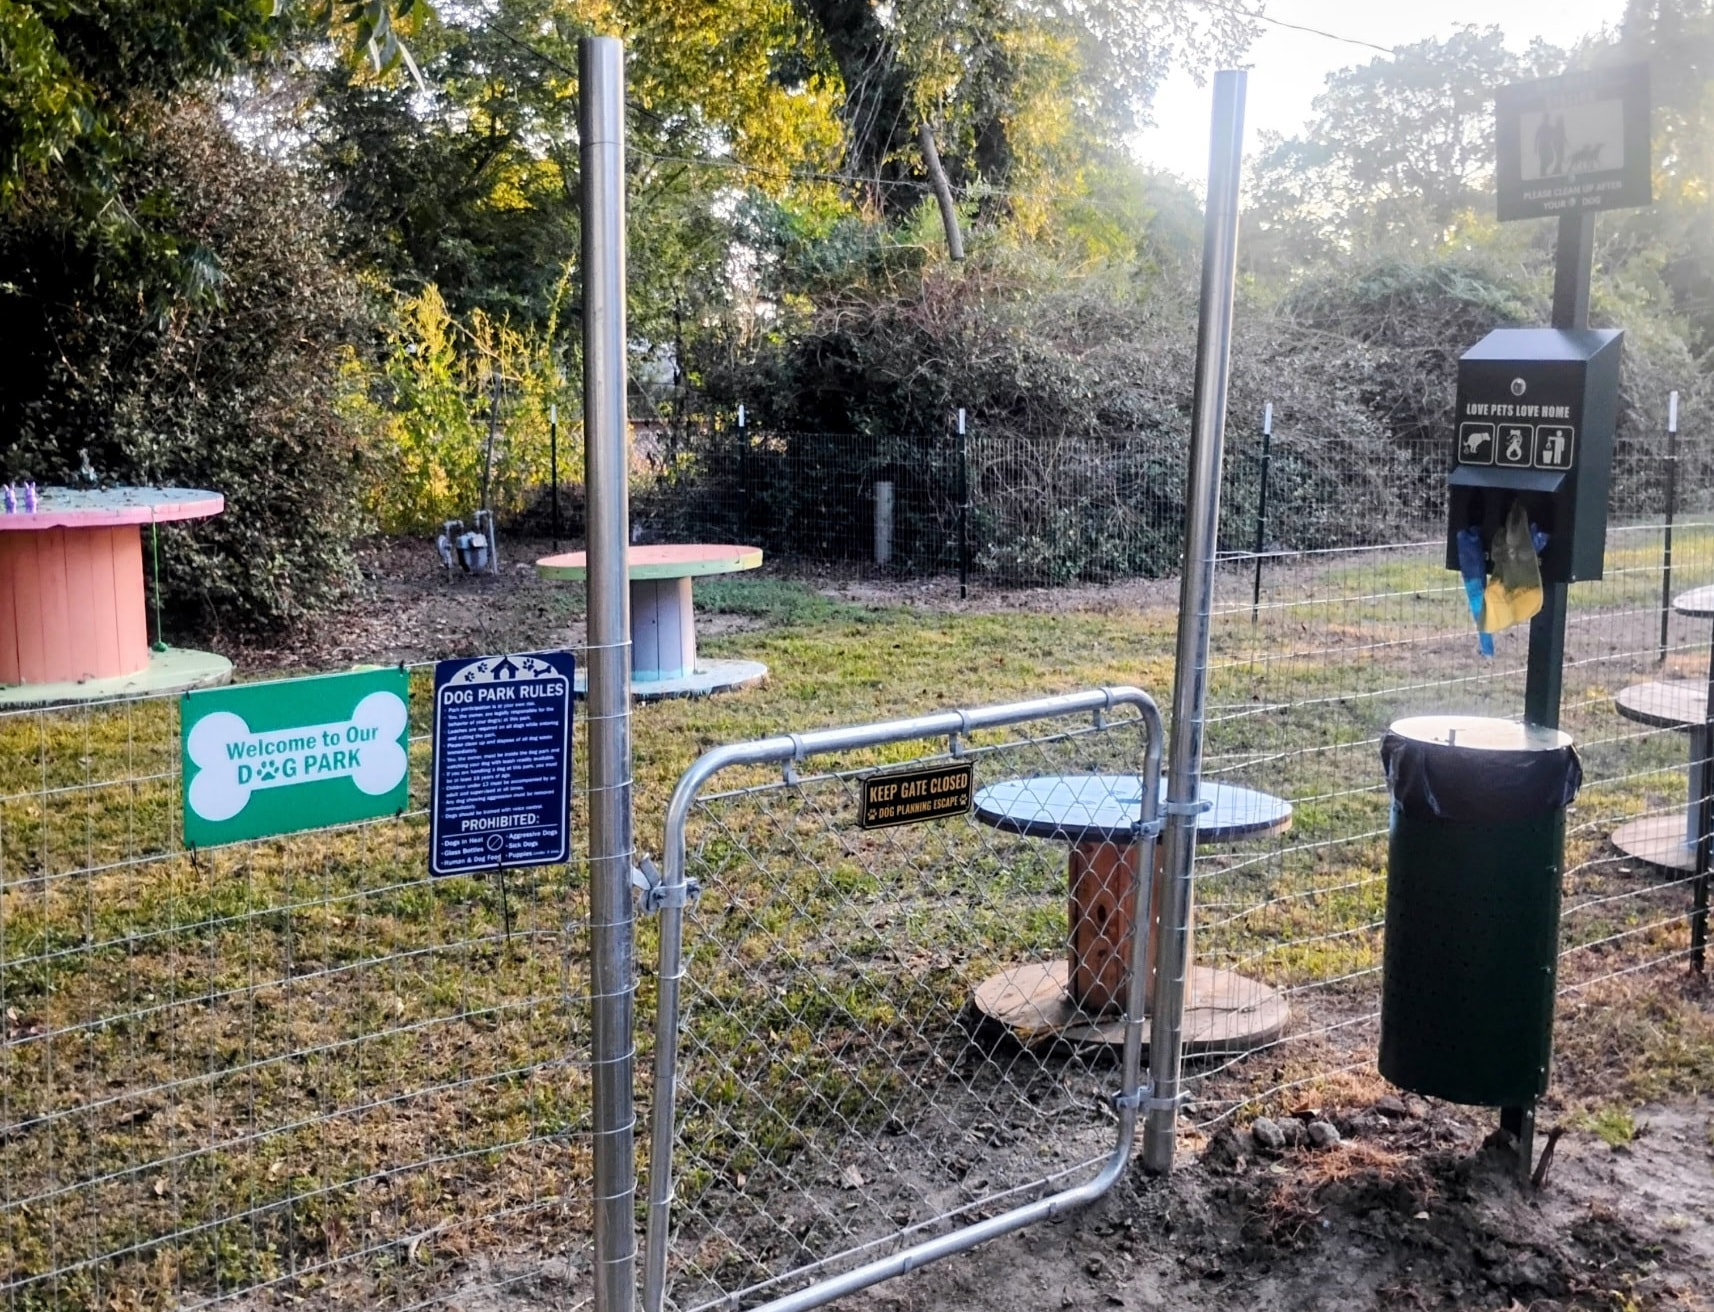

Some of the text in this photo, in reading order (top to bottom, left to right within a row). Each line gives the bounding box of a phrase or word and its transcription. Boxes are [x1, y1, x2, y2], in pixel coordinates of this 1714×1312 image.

[1523, 180, 1622, 200] PLEASE CLEAN UP AFTER
[1543, 195, 1601, 210] YOUR DOG
[1466, 403, 1570, 418] LOVE PETS LOVE HOME
[443, 683, 564, 705] DOG PARK RULES
[226, 726, 379, 760] Welcome to Our
[238, 748, 361, 785] DG PARK
[869, 773, 968, 803] KEEP GATE CLOSED
[879, 795, 958, 819] DOG PLANNING ESCAPE
[461, 813, 540, 832] PROHIBITED:
[444, 839, 460, 847] Dogs
[508, 829, 558, 840] Aggressive Dogs
